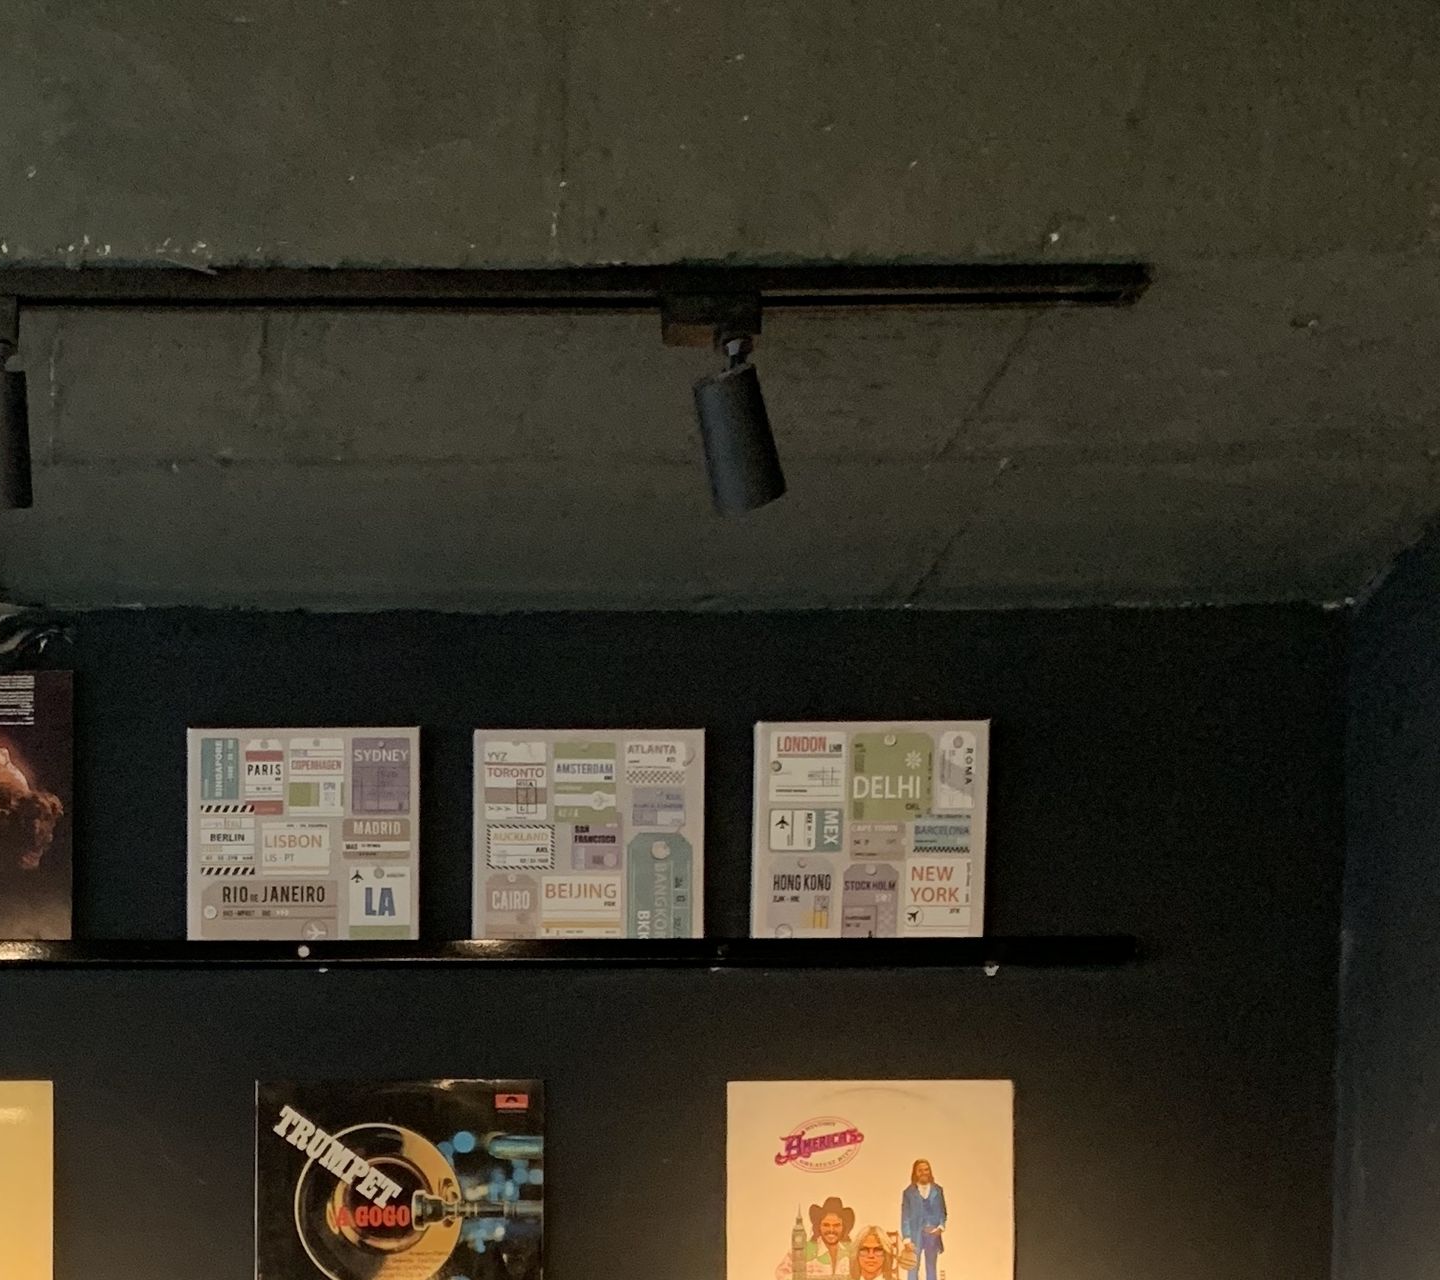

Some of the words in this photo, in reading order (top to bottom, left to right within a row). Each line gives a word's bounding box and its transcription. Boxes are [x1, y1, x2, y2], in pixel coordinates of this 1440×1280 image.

[628, 745, 676, 754] ATLANTA
[777, 736, 826, 752] LONDON
[354, 750, 408, 762] SYDNEY
[488, 752, 507, 761] YYZ
[247, 764, 281, 775] PARIS
[291, 759, 341, 769] COPENHAGEN
[556, 764, 613, 774] AMSTERDAM
[965, 748, 973, 785] ROMA
[488, 768, 544, 778] TORONTO
[853, 776, 920, 799] DELHI
[353, 822, 401, 834] MADRID
[575, 825, 589, 833] SAN
[823, 811, 839, 845] MEX
[915, 826, 969, 835] BARCELONA
[210, 834, 245, 842] BERLIN
[264, 834, 322, 848] LISBON
[493, 832, 548, 841] AUCKLAND
[912, 867, 953, 881] NEW
[773, 875, 802, 891] HONG
[804, 875, 831, 891] KONG
[845, 880, 896, 891] STOCKHOLM
[222, 886, 248, 903] RIO
[261, 886, 325, 903] JANEIRO
[545, 884, 617, 899] BEIJING
[911, 887, 959, 902] YORK
[364, 887, 396, 916] LA
[492, 891, 530, 909] CAIRO
[272, 1105, 402, 1209] TRUMPET
[336, 1207, 349, 1226] A
[353, 1206, 410, 1227] GOGO
